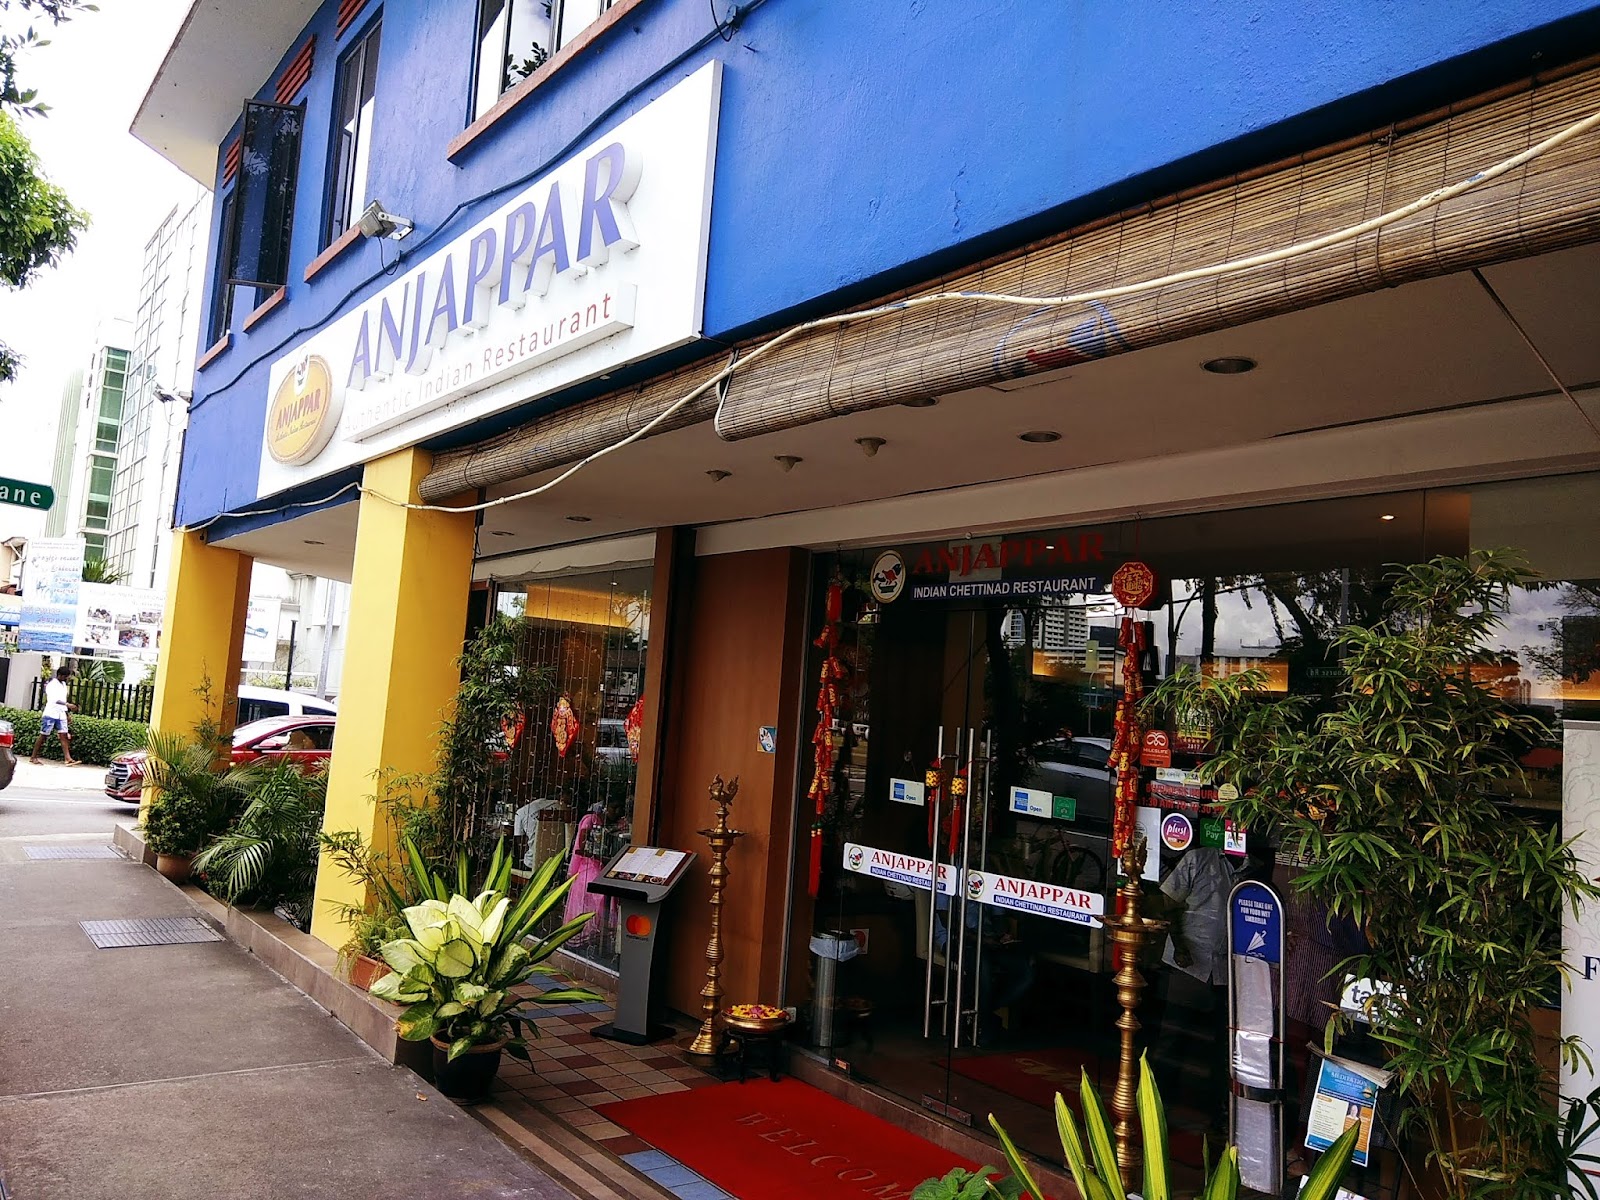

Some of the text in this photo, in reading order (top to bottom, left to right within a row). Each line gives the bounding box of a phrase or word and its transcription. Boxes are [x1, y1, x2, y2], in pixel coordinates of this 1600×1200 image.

[346, 141, 628, 389] ANJAPPAR
[344, 292, 612, 433] Authentic Indian Restaurant
[275, 388, 321, 431] ANJAPPAR
[0, 485, 41, 506] ane
[912, 533, 1105, 577] ANJAPPAR
[913, 576, 1096, 599] INDIAN CHETTINAD RESTAURANT
[1029, 805, 1043, 813] Open
[1204, 823, 1221, 832] Grab
[1205, 831, 1220, 841] Pay
[871, 866, 945, 891] INDIAN CHETTINAD RESTAUNT
[993, 877, 1092, 909] ANJAPPAR
[995, 895, 1089, 923] INDIAN CHETTINAD RESTAURANT
[1240, 906, 1271, 918] FOR YOUR WET
[1253, 901, 1264, 909] TAKE
[1264, 903, 1274, 911] ONE
